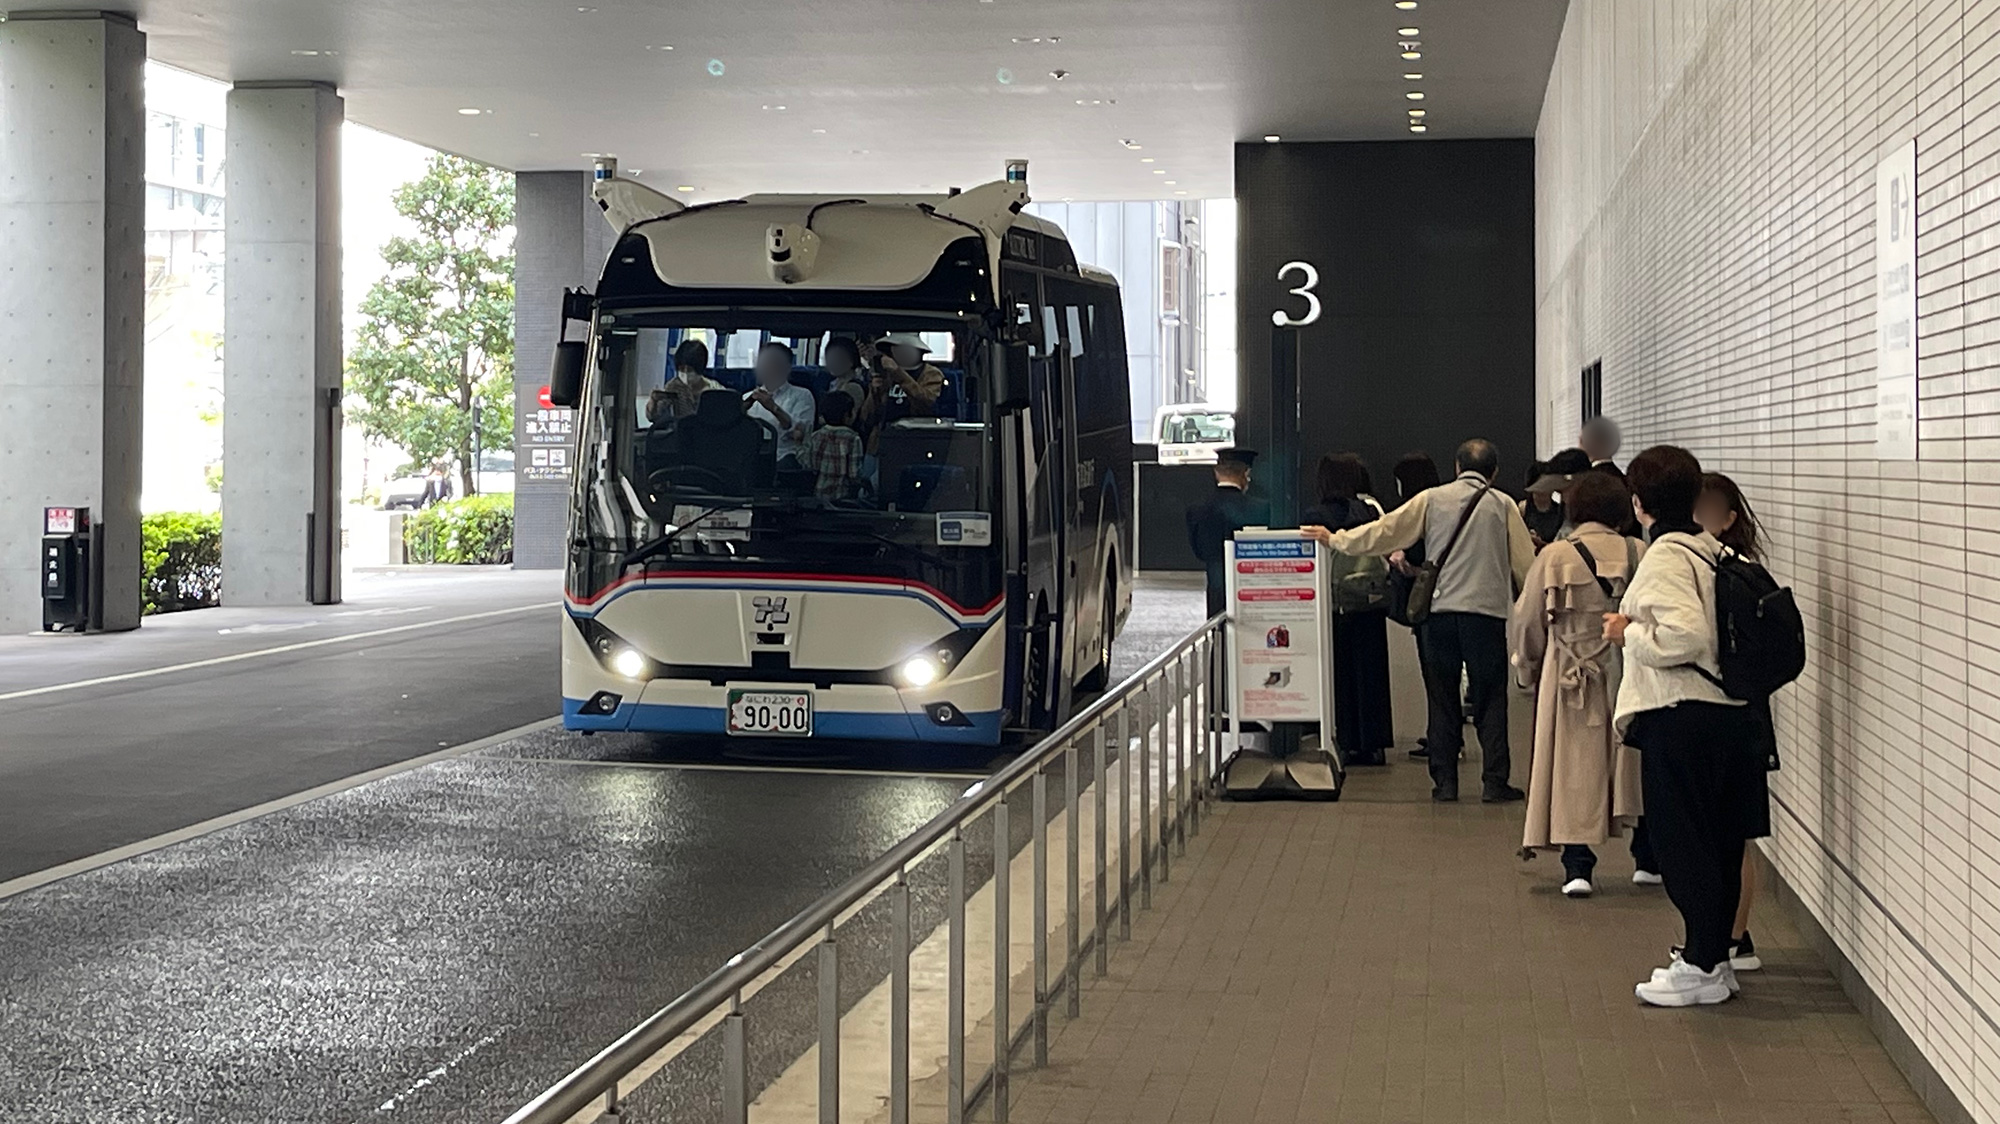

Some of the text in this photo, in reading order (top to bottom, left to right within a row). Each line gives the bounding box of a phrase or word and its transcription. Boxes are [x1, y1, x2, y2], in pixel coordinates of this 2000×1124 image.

[1272, 261, 1320, 326] 3
[525, 421, 572, 433] 進入禁止
[744, 706, 804, 729] 90-00
